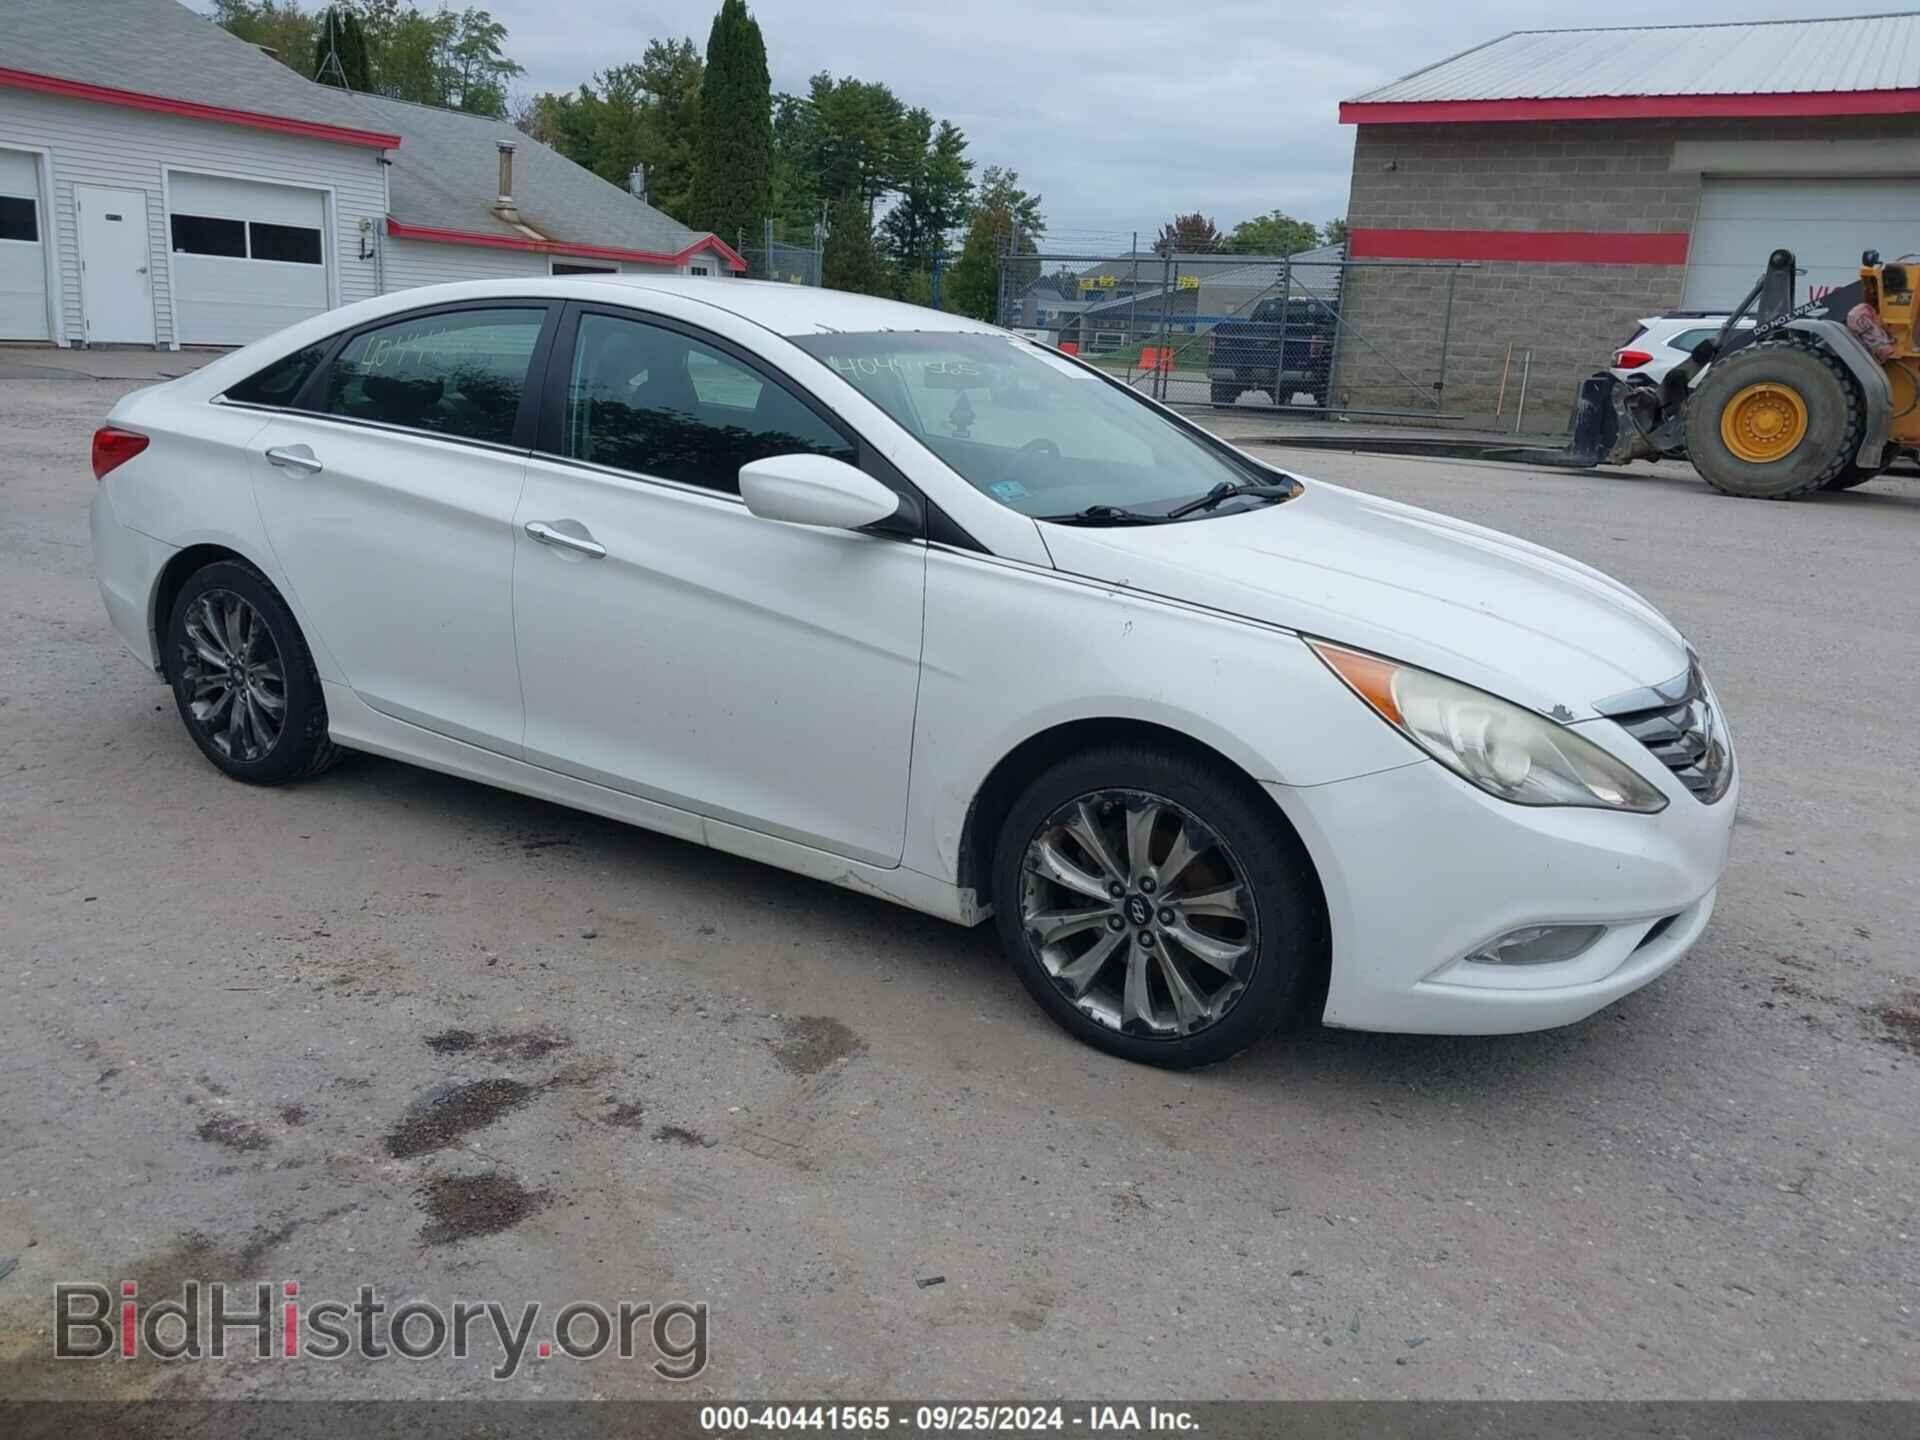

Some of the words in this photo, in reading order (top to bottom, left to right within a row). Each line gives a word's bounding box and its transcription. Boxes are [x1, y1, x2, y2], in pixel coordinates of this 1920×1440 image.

[1753, 323, 1769, 336] DO
[1770, 313, 1793, 330] NOT
[1793, 300, 1824, 316] WALK
